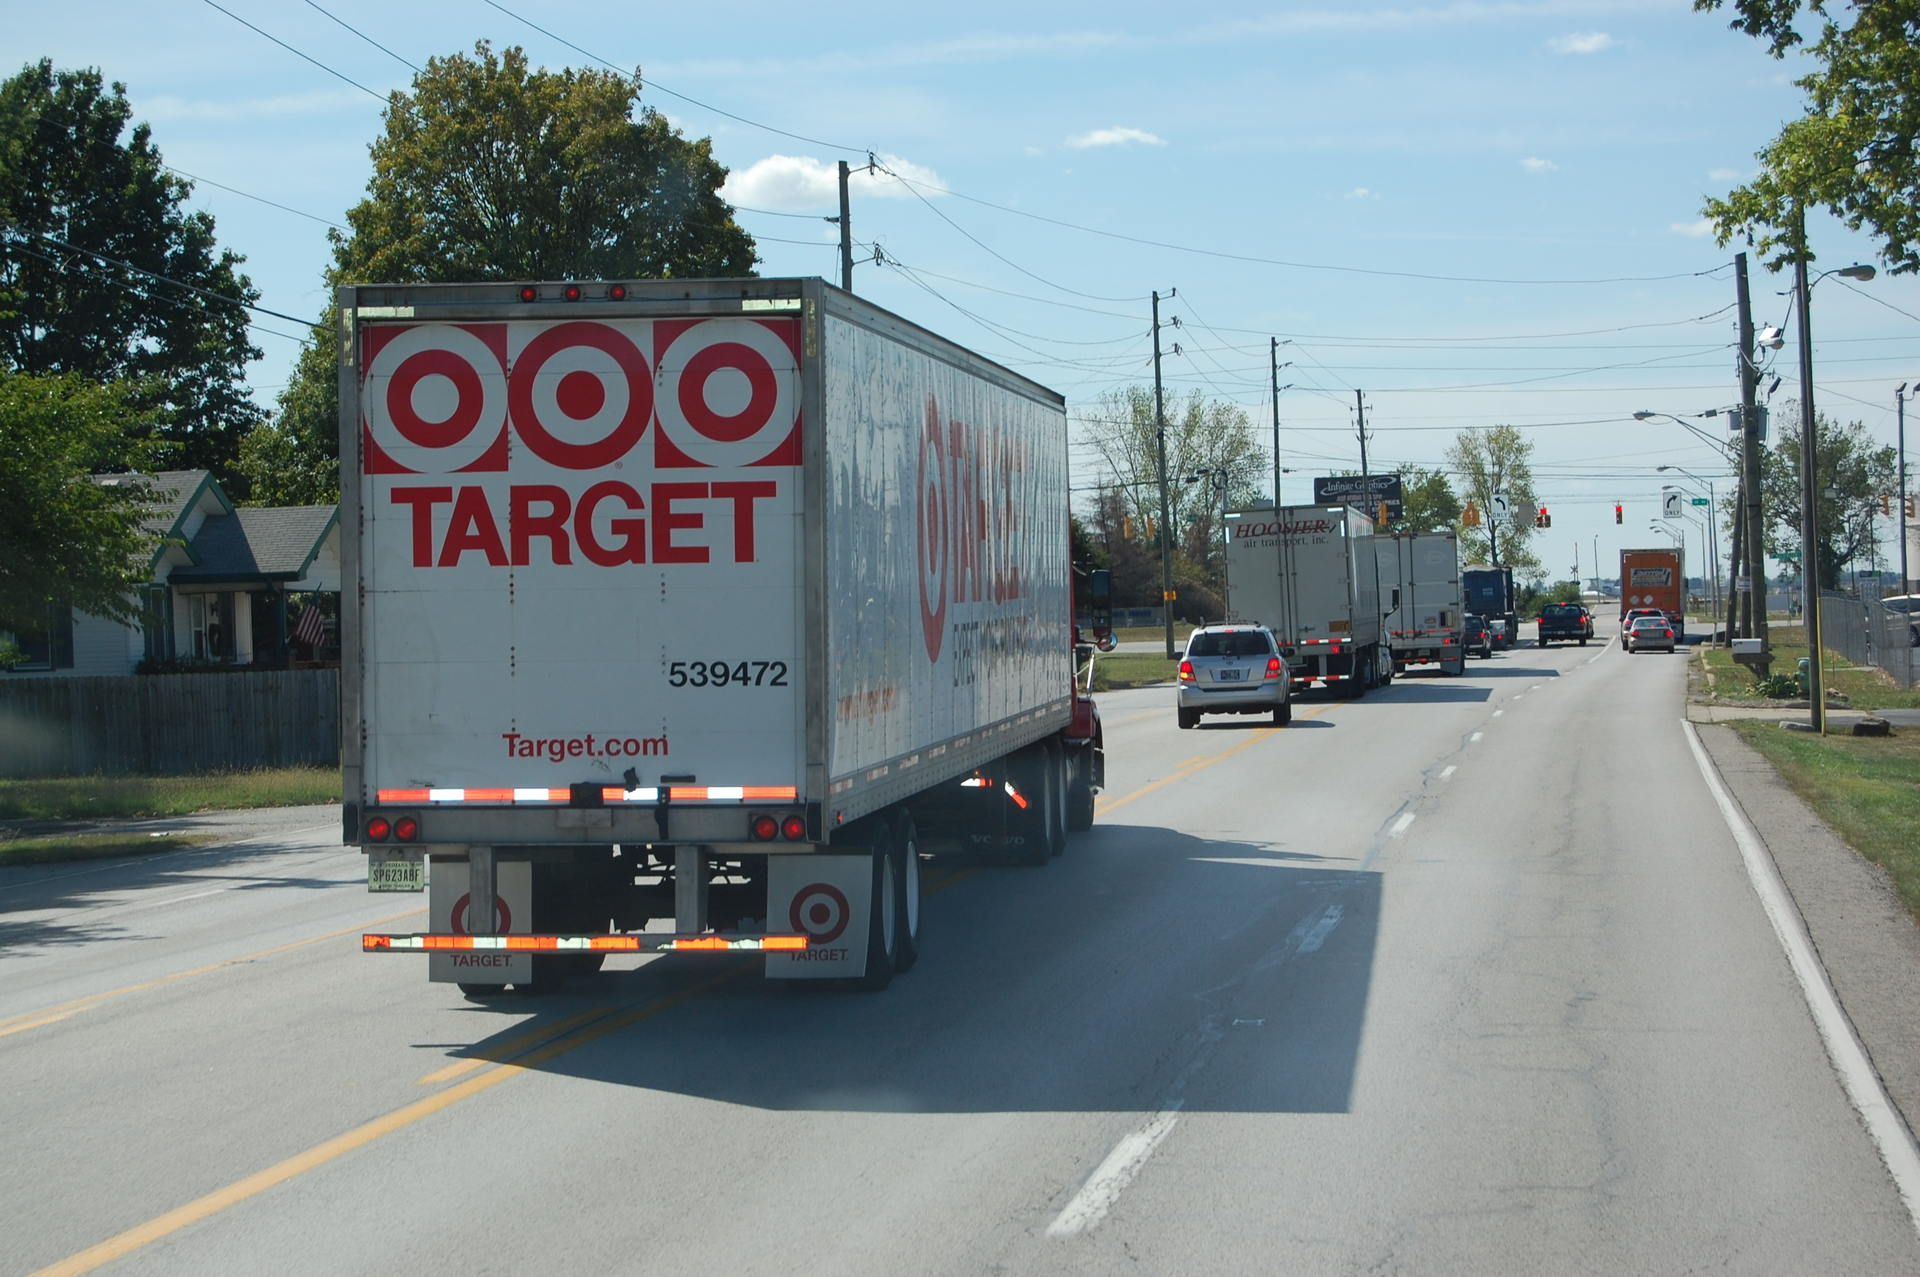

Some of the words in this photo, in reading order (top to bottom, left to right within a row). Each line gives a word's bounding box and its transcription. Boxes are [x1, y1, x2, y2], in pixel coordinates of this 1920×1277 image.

[1327, 481, 1354, 491] Infinite
[1354, 480, 1388, 492] Grphics
[390, 480, 777, 568] TARGET
[1234, 519, 1327, 539] HOOSIER
[1243, 539, 1257, 549] air
[1312, 535, 1330, 545] inc.
[668, 660, 789, 688] 539472
[502, 733, 669, 762] Target.com
[970, 834, 1025, 845] VOVO
[373, 868, 421, 882] SP623ABF
